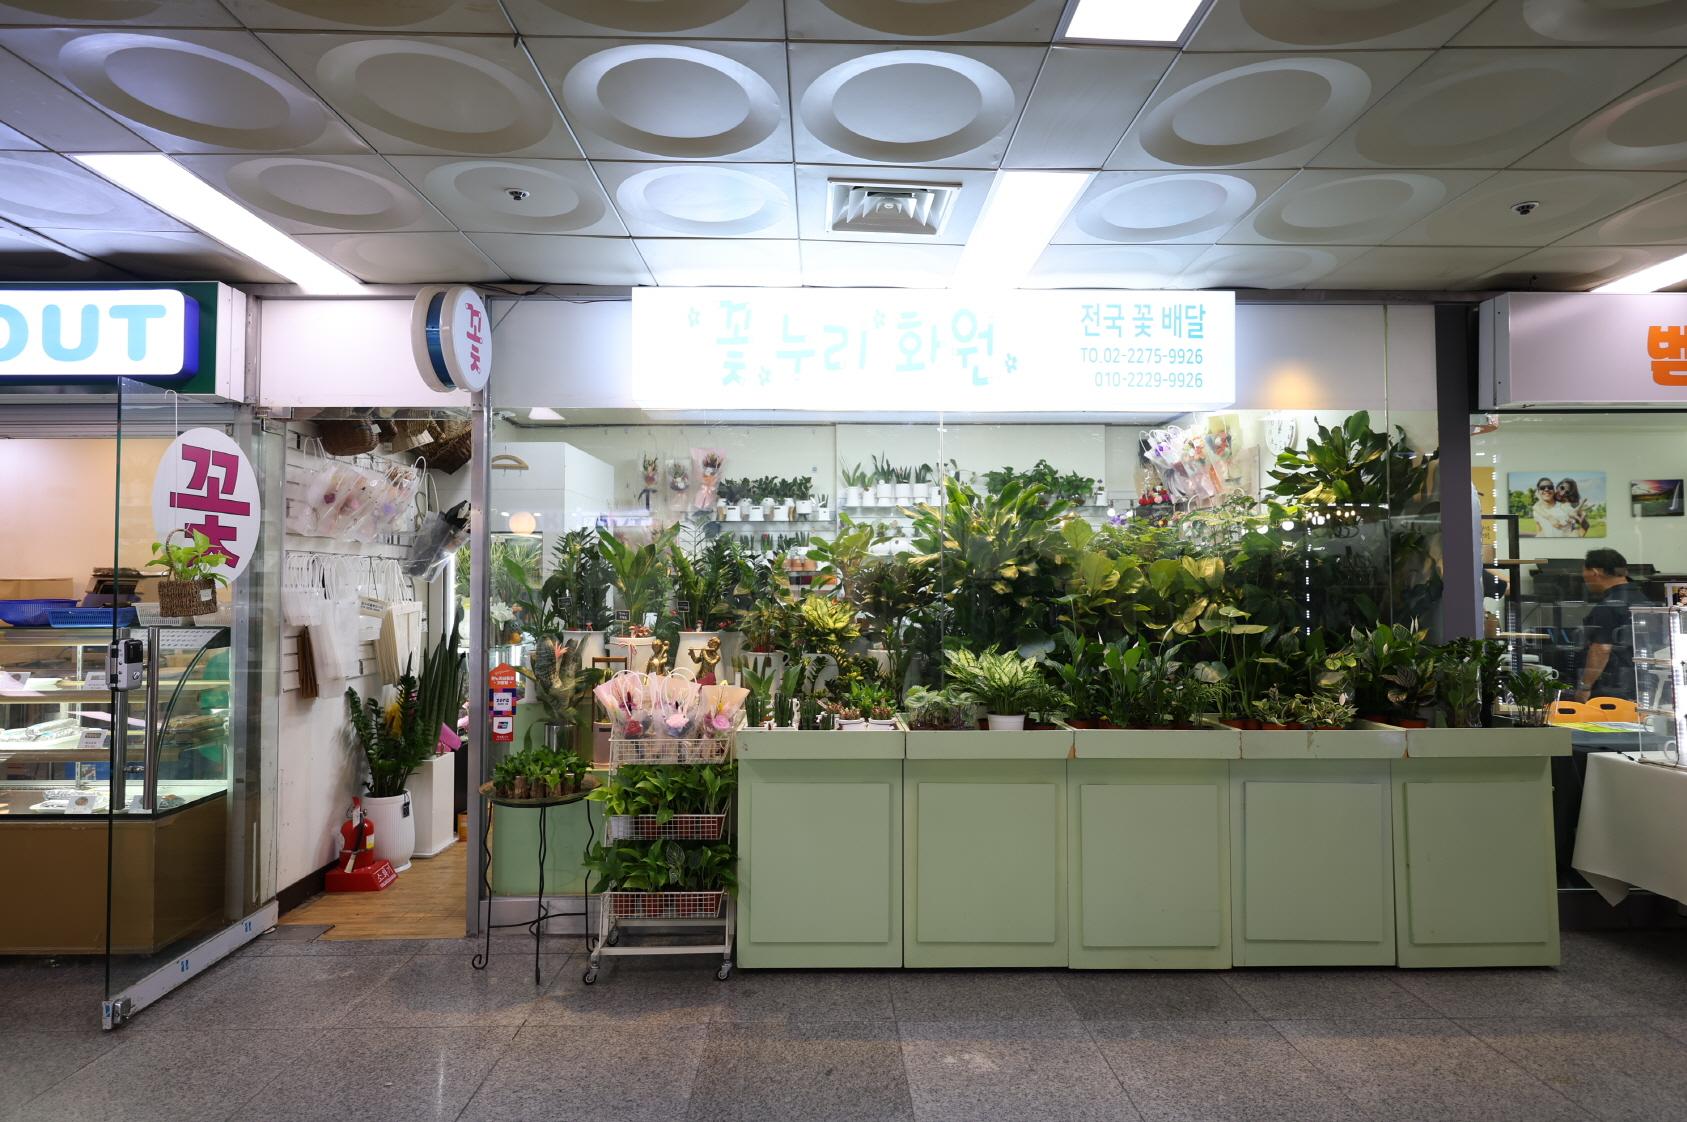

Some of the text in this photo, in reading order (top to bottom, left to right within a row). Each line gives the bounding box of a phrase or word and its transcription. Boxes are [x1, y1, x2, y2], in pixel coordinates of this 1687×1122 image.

[1081, 303, 1206, 339] 전국 꽃 배달
[1094, 371, 1204, 388] 010-2229-9926
[169, 443, 251, 569] 꽃
